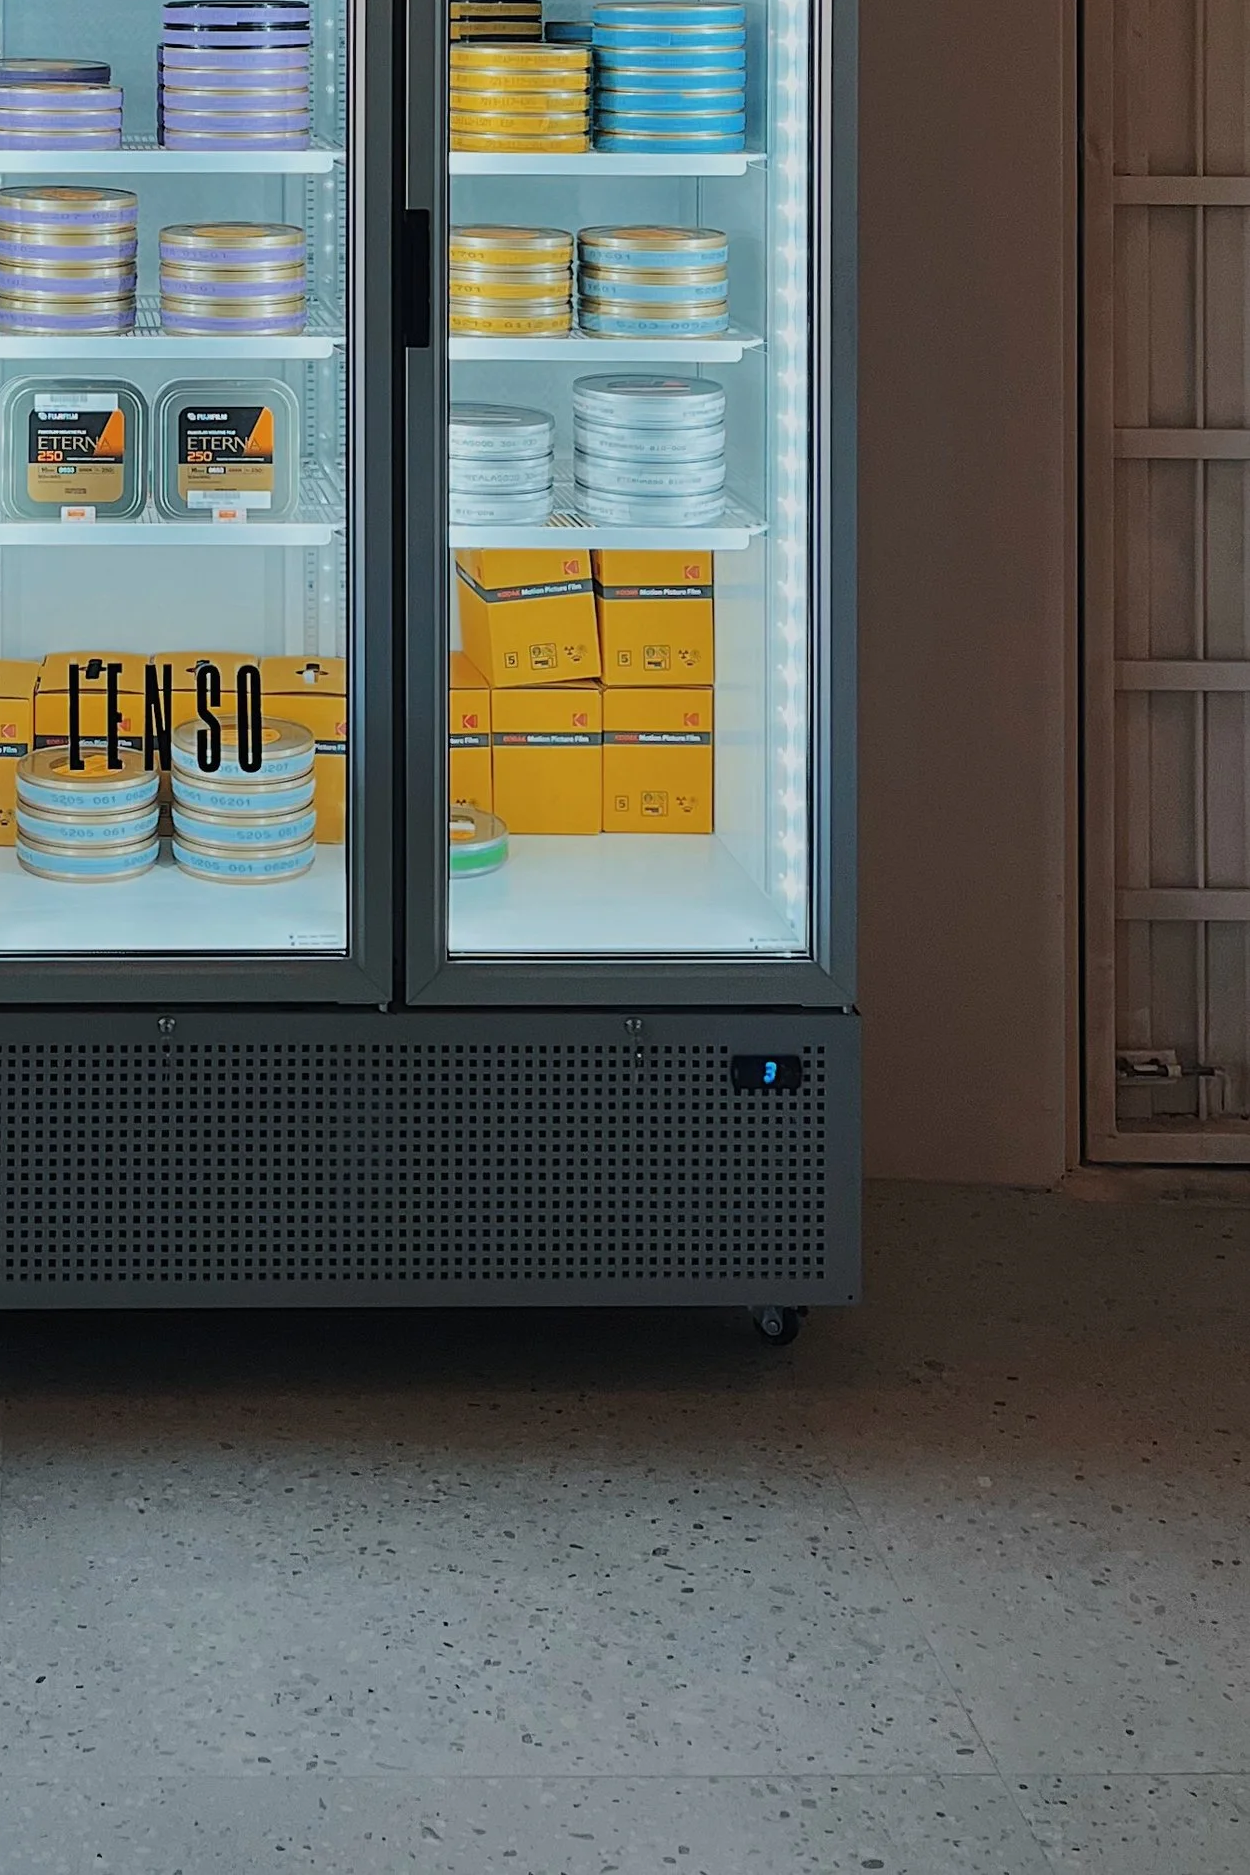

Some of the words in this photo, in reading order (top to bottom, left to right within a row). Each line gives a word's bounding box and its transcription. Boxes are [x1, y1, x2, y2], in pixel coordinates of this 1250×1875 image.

[37, 436, 112, 453] ETERNA
[187, 436, 262, 453] ETERNA
[37, 450, 63, 462] 250
[186, 451, 213, 463] 250
[567, 582, 582, 592] Film
[687, 588, 702, 597] Film
[508, 655, 515, 665] 5
[621, 654, 629, 664] 5
[69, 663, 262, 774] LENSO
[464, 735, 480, 744] Film
[574, 734, 590, 744] Film
[2, 746, 18, 754] Film
[93, 794, 116, 804] 061
[210, 797, 251, 808] 06201
[618, 798, 626, 809] 5
[103, 827, 126, 837] 061
[763, 1060, 778, 1085] 3
